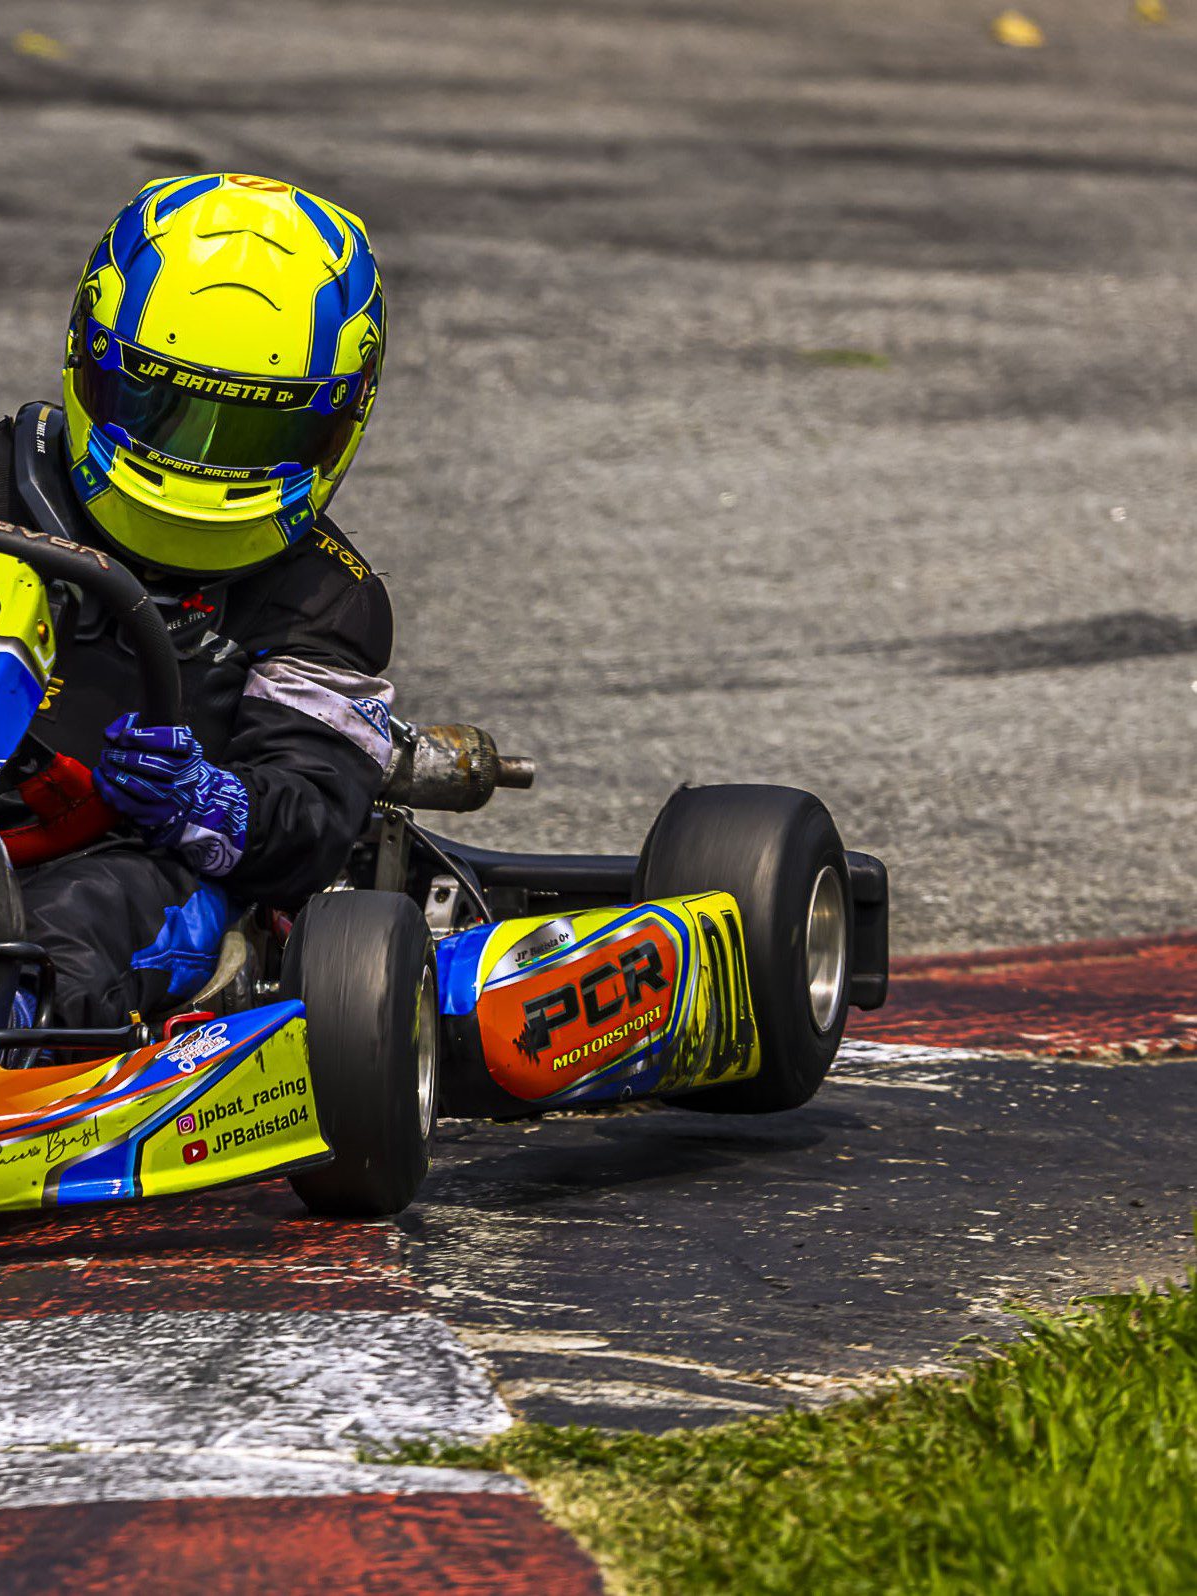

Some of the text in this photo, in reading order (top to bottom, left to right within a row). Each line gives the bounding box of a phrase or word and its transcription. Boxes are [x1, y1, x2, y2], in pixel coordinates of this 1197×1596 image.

[138, 362, 169, 377] JP
[172, 371, 271, 401] BATISTA
[333, 384, 346, 403] JP
[146, 451, 251, 479] @JPBAT_RACING
[515, 950, 528, 962] JP
[517, 939, 670, 1055] PCR
[553, 1005, 663, 1071] MOTORSPORT
[197, 1074, 307, 1132] jpbat_racing
[211, 1105, 309, 1155] JPBatista04
